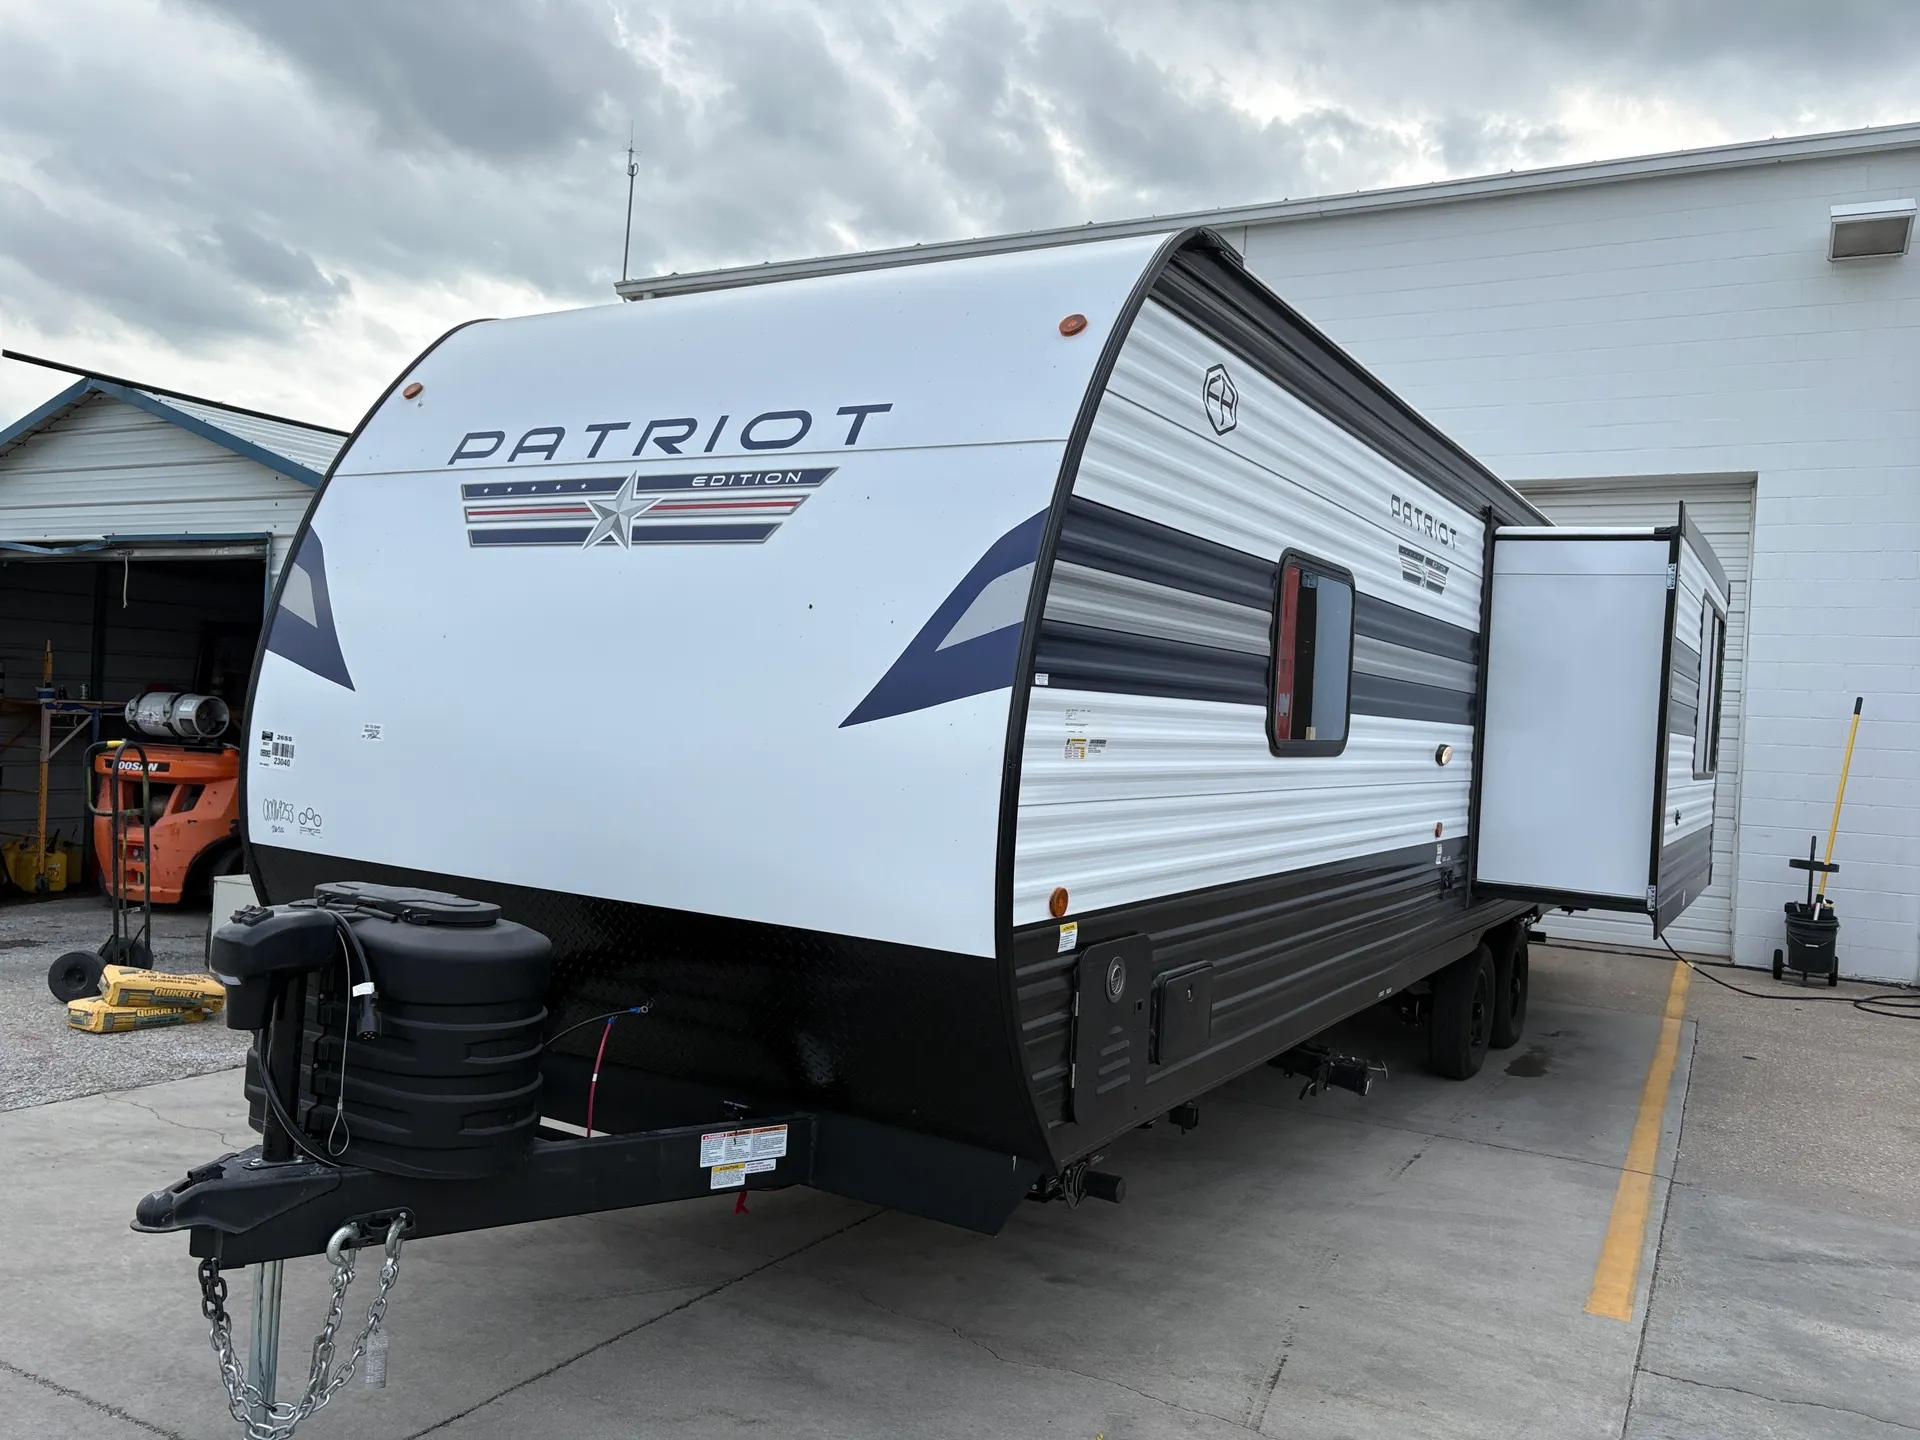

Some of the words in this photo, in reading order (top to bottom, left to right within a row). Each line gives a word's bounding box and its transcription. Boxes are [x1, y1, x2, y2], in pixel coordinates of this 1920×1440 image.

[447, 403, 893, 465] PATRIOT
[692, 472, 801, 487] EDITION
[1391, 494, 1456, 550] PATRIOT
[273, 757, 290, 767] 23040
[154, 987, 204, 999] QUIKRETE
[136, 1007, 183, 1017] QUIKRETE
